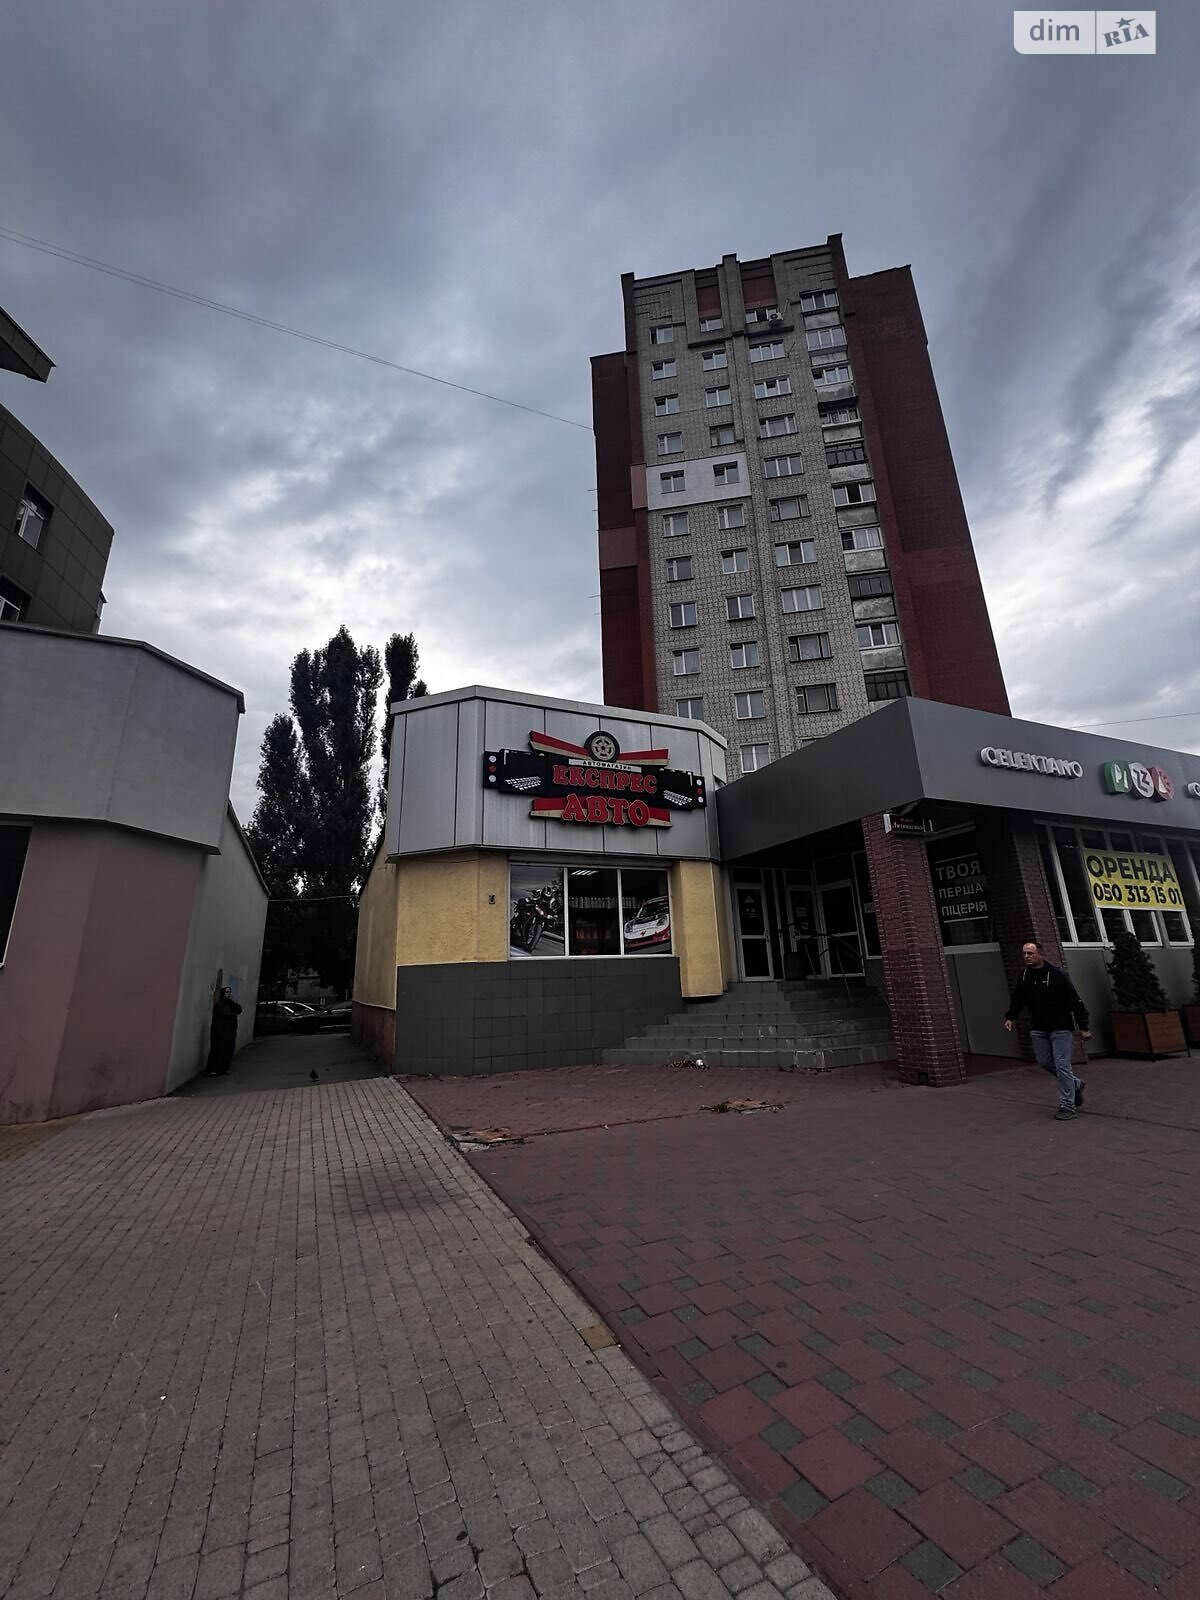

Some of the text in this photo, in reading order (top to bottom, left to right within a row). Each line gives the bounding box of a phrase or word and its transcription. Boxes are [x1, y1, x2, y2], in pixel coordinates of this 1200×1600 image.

[980, 746, 1084, 778] CELENTANO
[552, 764, 658, 795] ЕКСПРЕС
[561, 793, 650, 828] АВТО
[935, 859, 982, 881] ТВОЯ
[1086, 855, 1176, 884] ОРЕНДА
[938, 882, 985, 900] ПЕРША
[1093, 882, 1183, 905] 050 313 15 01
[941, 900, 988, 917] ПІЦЕРІЯ
